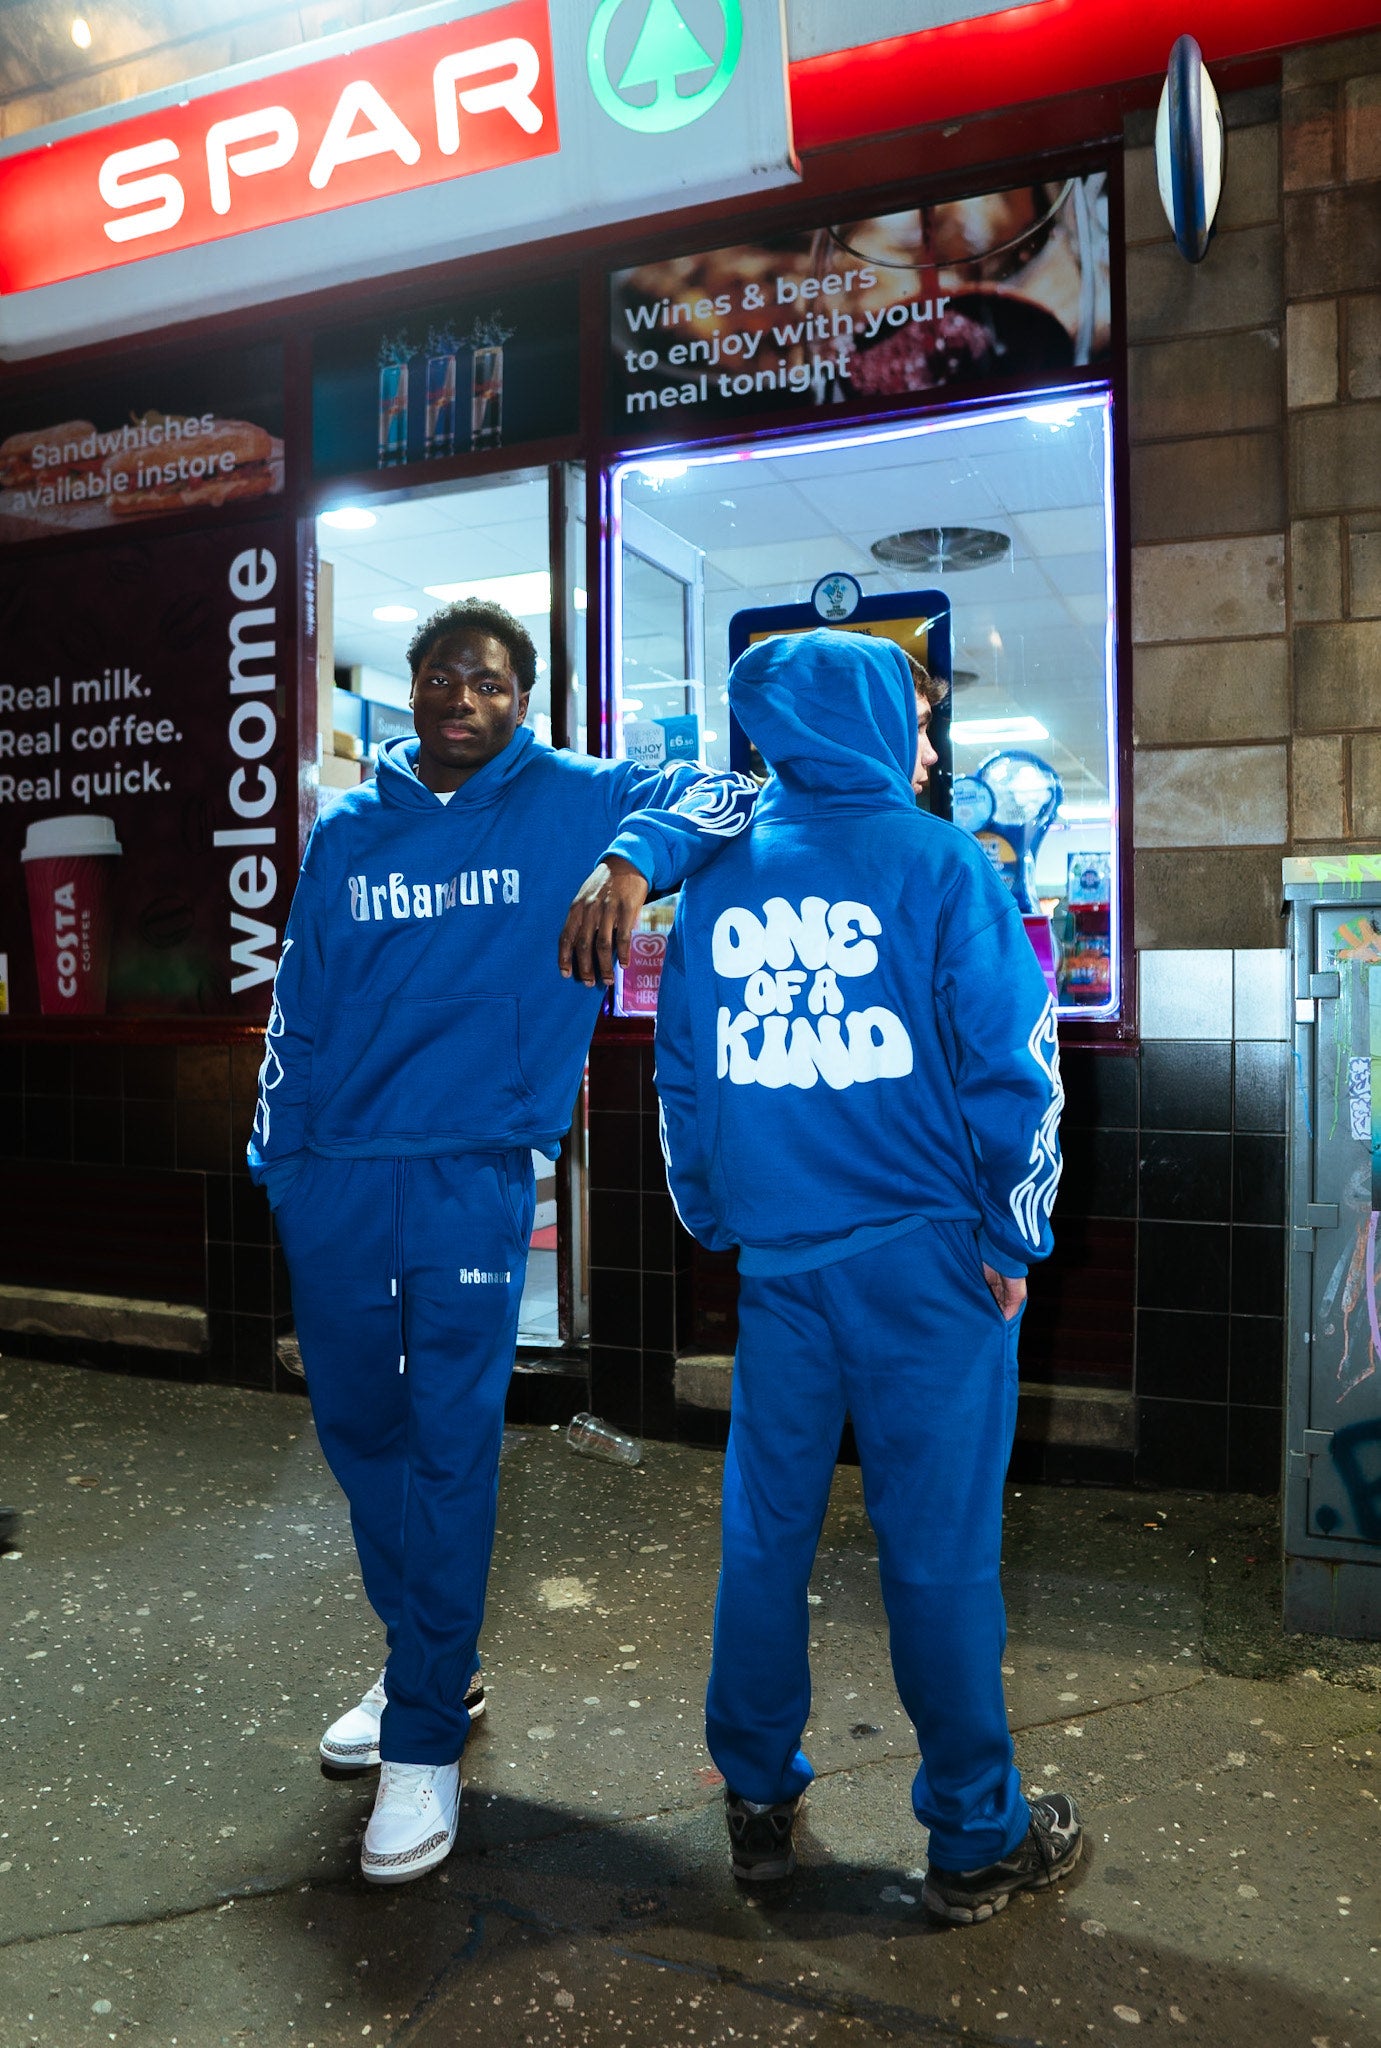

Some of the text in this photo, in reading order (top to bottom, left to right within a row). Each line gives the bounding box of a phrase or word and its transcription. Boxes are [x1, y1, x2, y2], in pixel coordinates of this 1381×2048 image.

[98, 36, 544, 243] SPAR
[625, 266, 878, 332] Wines & beers
[625, 295, 951, 373] to enjoy with your
[626, 351, 851, 414] meal tonight
[32, 412, 215, 470] Sandwhiches
[12, 450, 236, 511] available instore
[72, 667, 151, 704] milk.
[71, 714, 183, 751] coffee.
[627, 743, 663, 756] ENJOY
[71, 760, 171, 804] quick.
[213, 547, 278, 994] welcome
[54, 882, 79, 998] COSTA
[81, 910, 91, 972] COFFEE
[712, 896, 883, 978] ONE
[744, 968, 845, 1016] OF A
[716, 1006, 914, 1091] KIND
